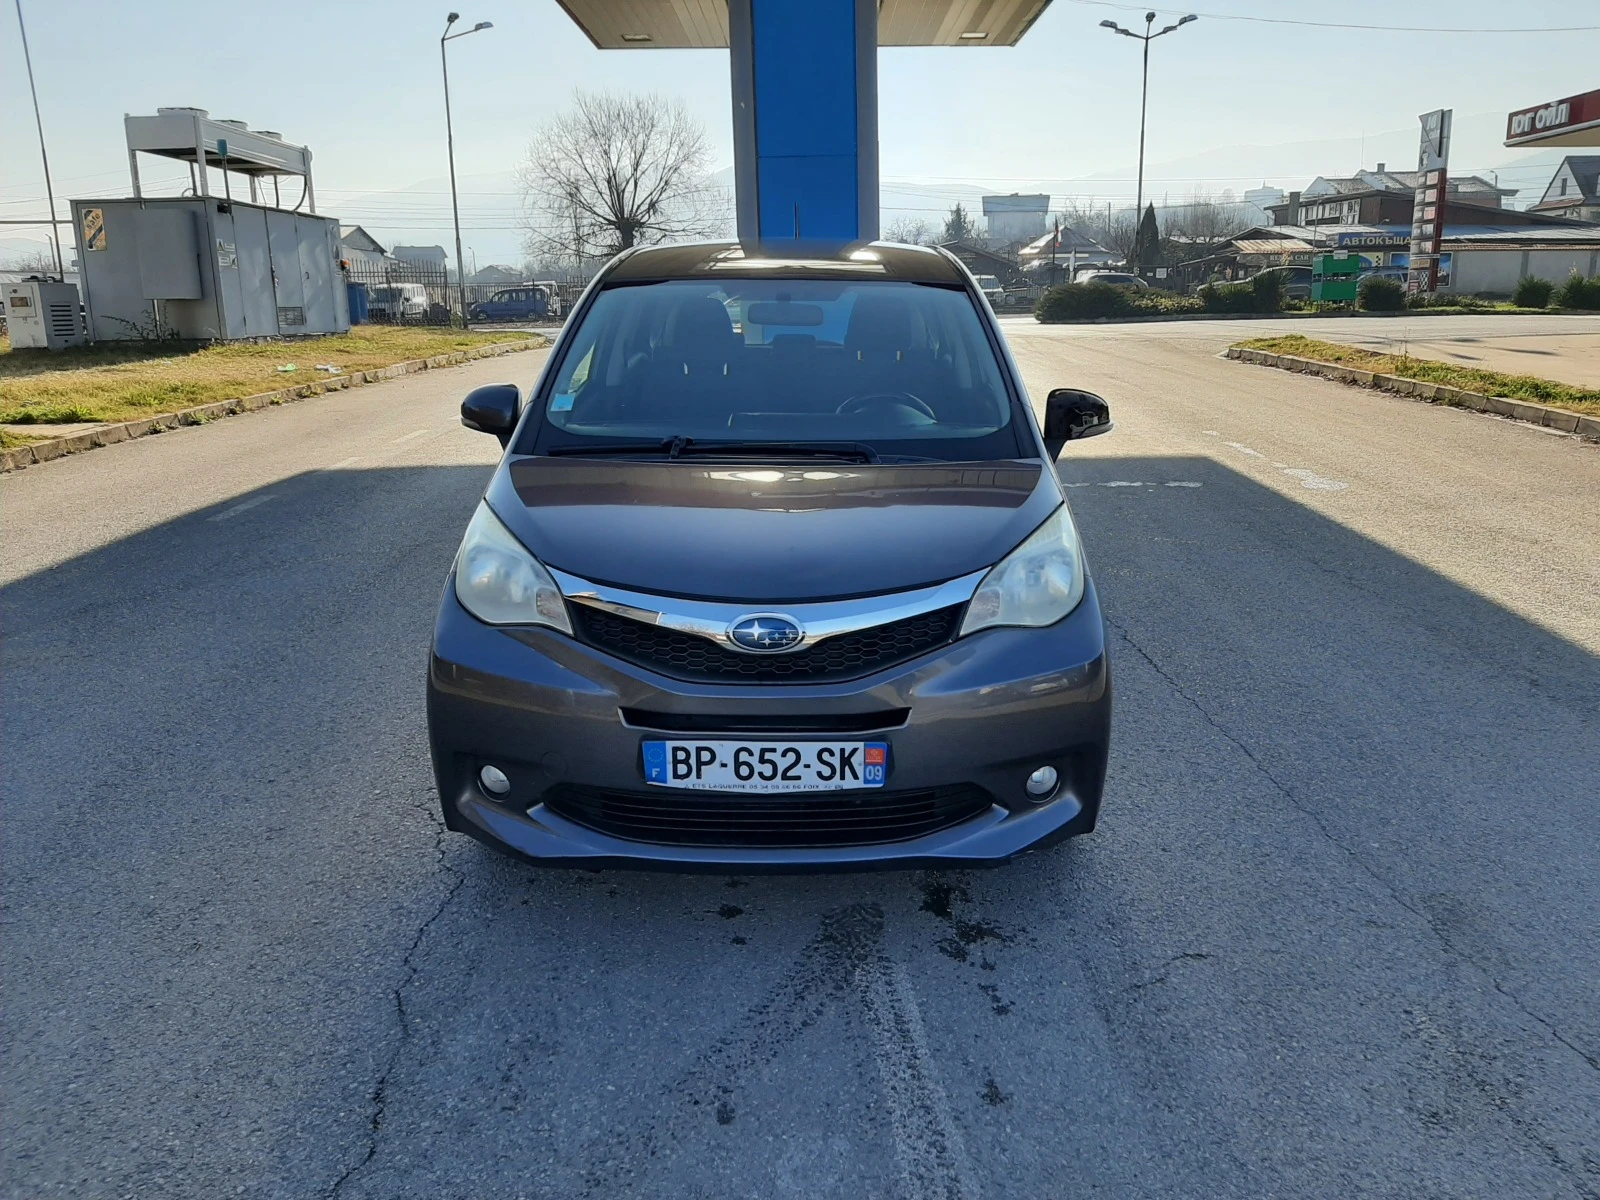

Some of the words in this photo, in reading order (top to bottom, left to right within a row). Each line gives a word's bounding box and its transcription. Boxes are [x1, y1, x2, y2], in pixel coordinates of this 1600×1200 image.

[1511, 112, 1534, 135] ЮГ
[1535, 101, 1570, 129] ОЙЛ
[1342, 236, 1411, 246] АВТОКЪЩА
[671, 745, 860, 782] BP-652-SK
[652, 768, 660, 778] F
[865, 765, 883, 781] 09
